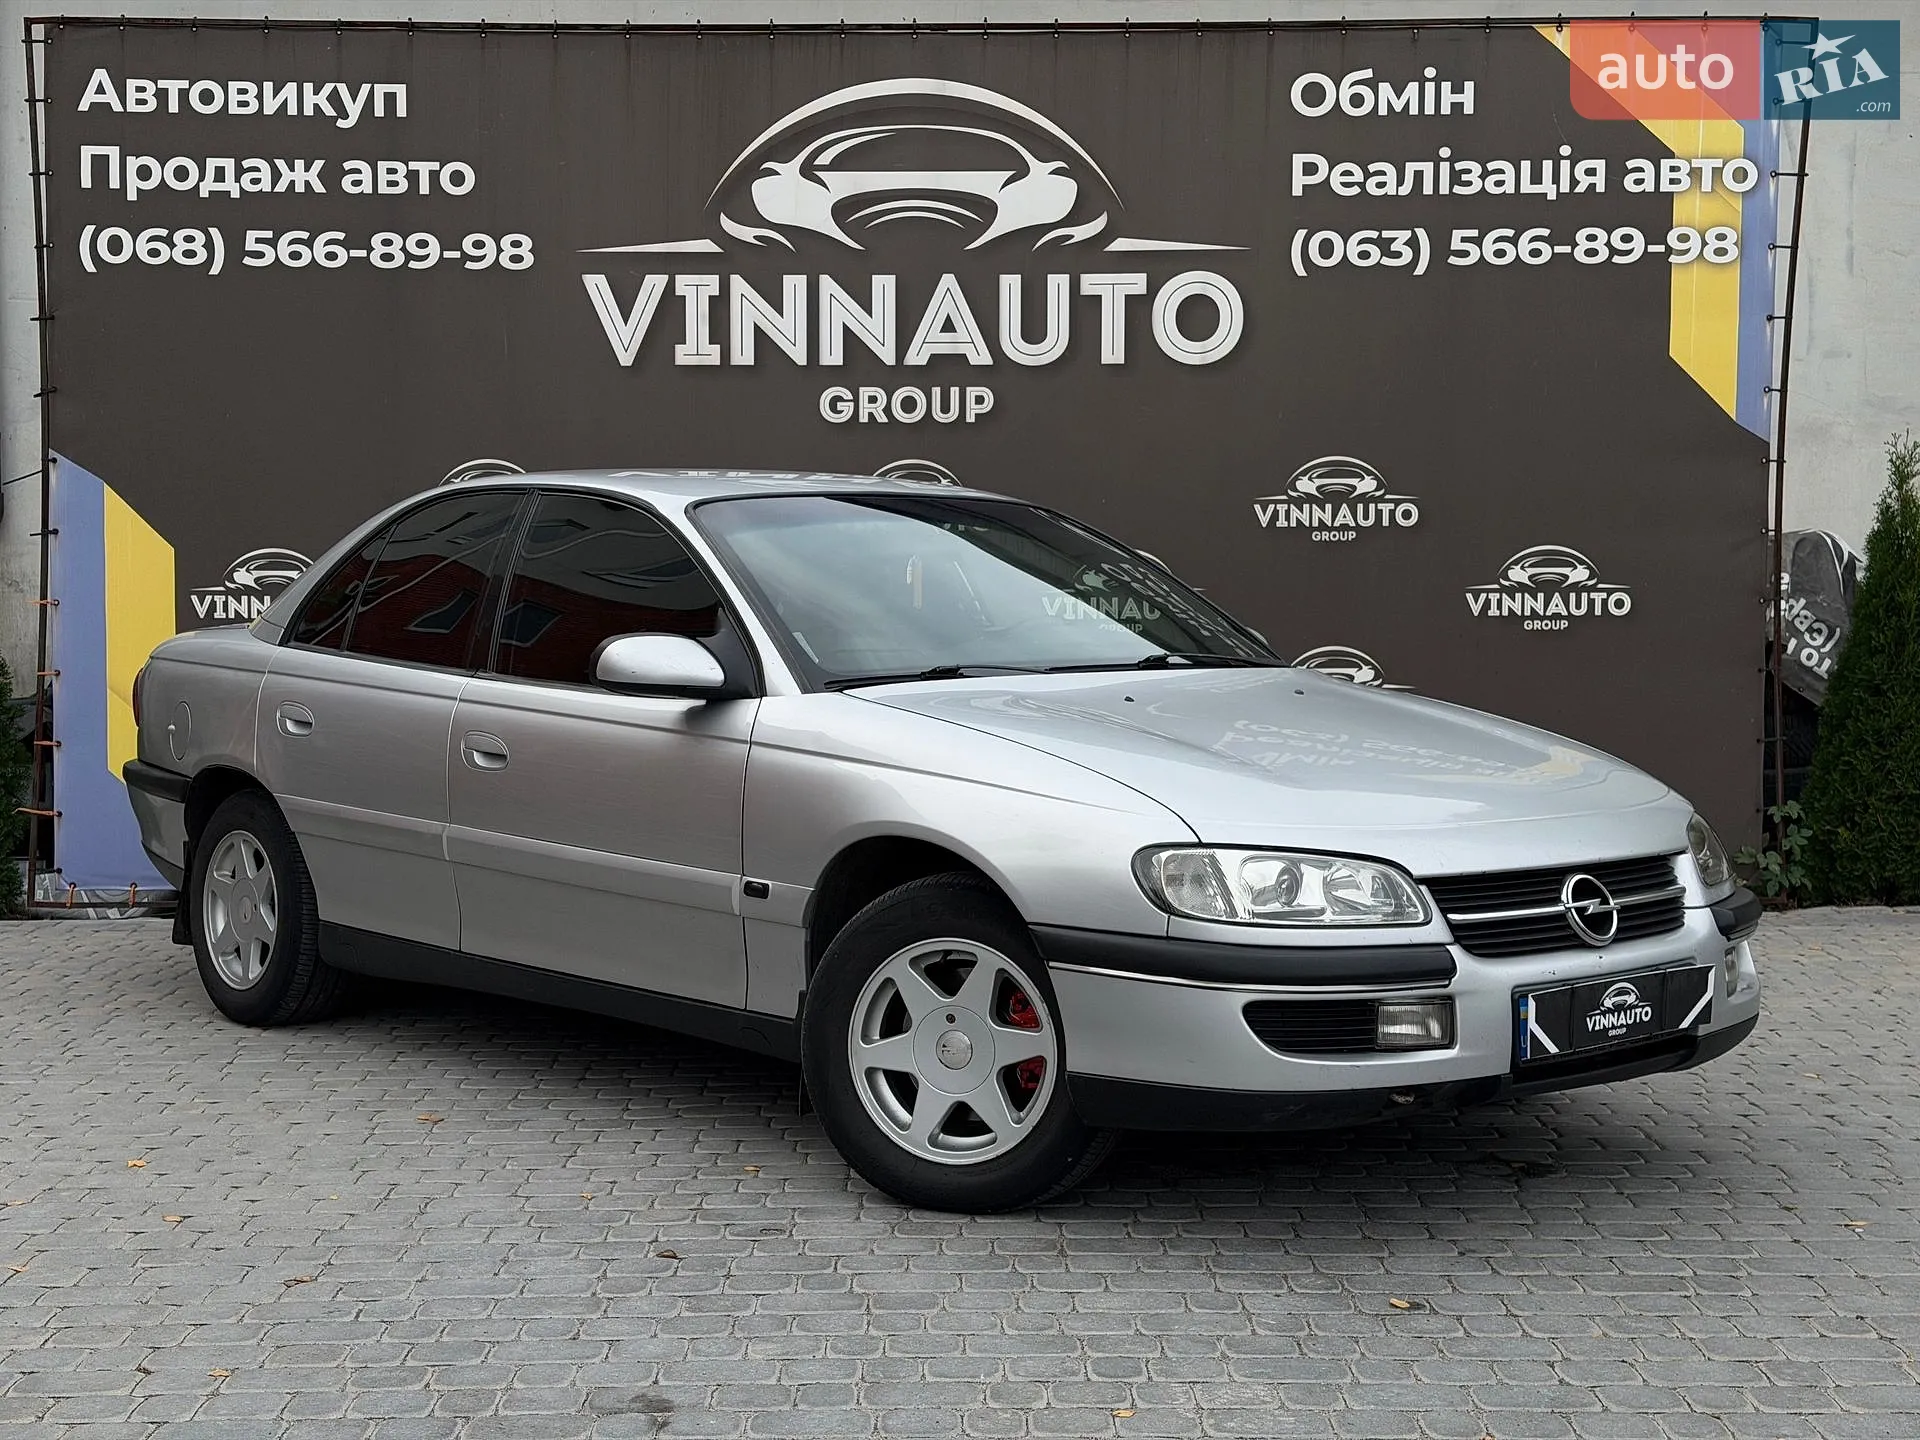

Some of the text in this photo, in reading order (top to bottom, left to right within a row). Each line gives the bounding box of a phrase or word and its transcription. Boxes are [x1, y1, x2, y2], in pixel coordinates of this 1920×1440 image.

[78, 68, 408, 129] Автовикуп
[1290, 66, 1476, 117] Обмін
[80, 145, 476, 201] Продаж авто
[1291, 145, 1759, 201] Реалізація авто
[78, 224, 535, 275] (068) 566-89-98
[1290, 226, 1739, 277] (063) 566-89-98
[581, 270, 1244, 367] VINNAUTO
[819, 386, 994, 424] GROUP
[1253, 502, 1419, 528] VINNAUTO
[1311, 530, 1356, 541] GROUP
[1465, 590, 1632, 617] VINNAUTO
[1523, 619, 1569, 630] GROUP
[1586, 1006, 1652, 1032] VINNAUTO
